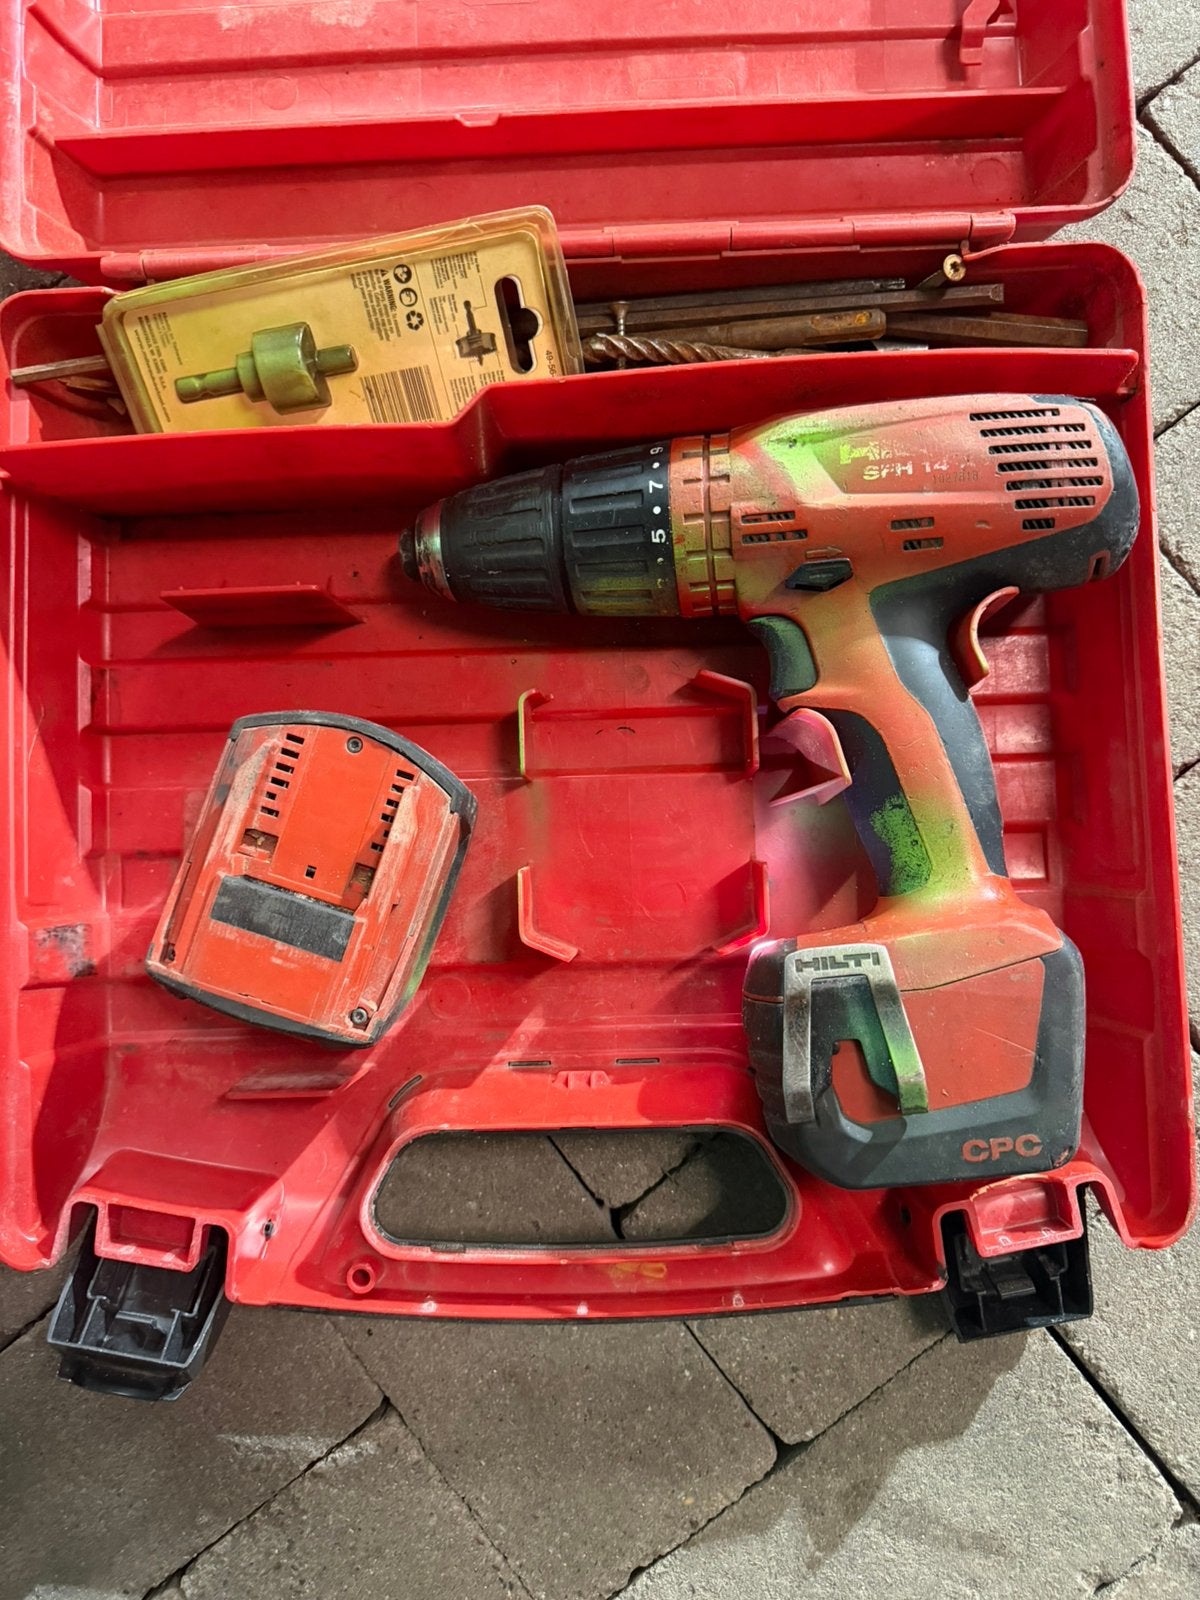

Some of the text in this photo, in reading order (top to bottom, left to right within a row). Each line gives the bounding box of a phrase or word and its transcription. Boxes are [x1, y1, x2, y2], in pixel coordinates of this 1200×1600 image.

[383, 278, 398, 312] WARNING:
[649, 446, 666, 543] 5 7 9
[795, 952, 880, 973] HILTI
[962, 1134, 1043, 1163] CPC
